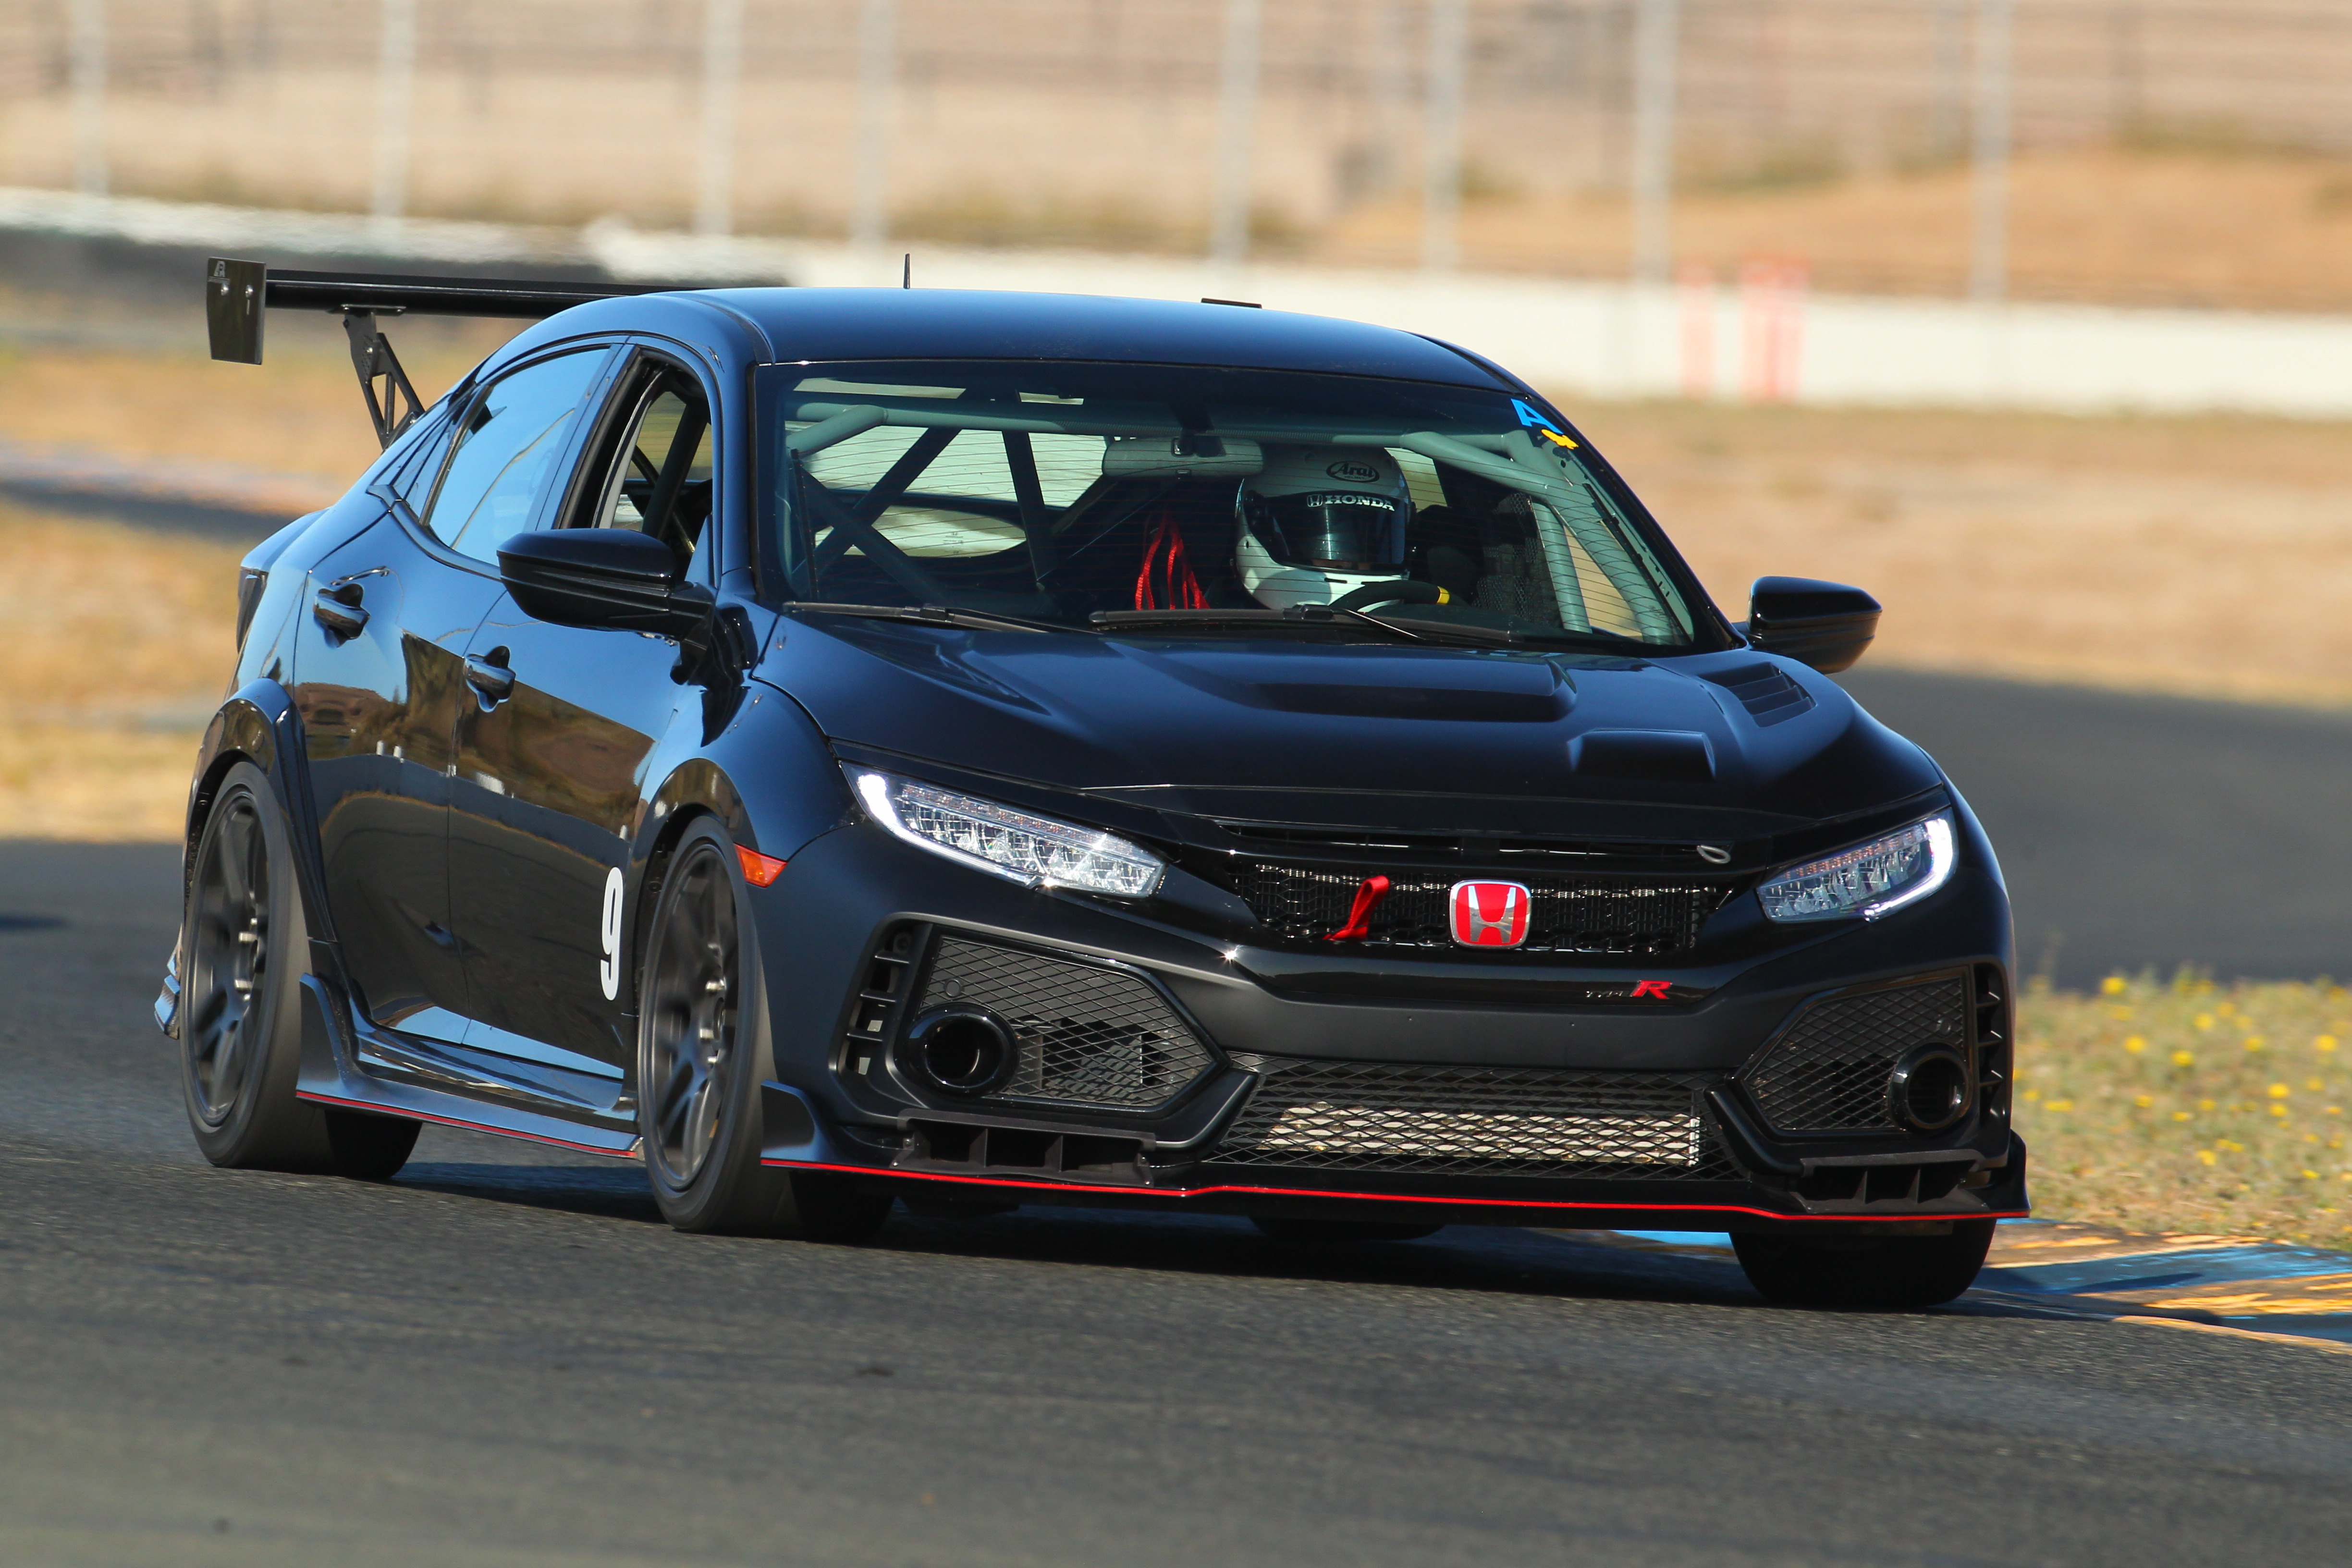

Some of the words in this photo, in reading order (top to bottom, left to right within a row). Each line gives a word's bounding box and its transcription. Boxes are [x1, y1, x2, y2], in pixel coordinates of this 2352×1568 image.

[1331, 462, 1373, 477] Arai
[1325, 495, 1395, 511] HONDA
[600, 867, 624, 1001] 9
[1630, 980, 1673, 999] R
